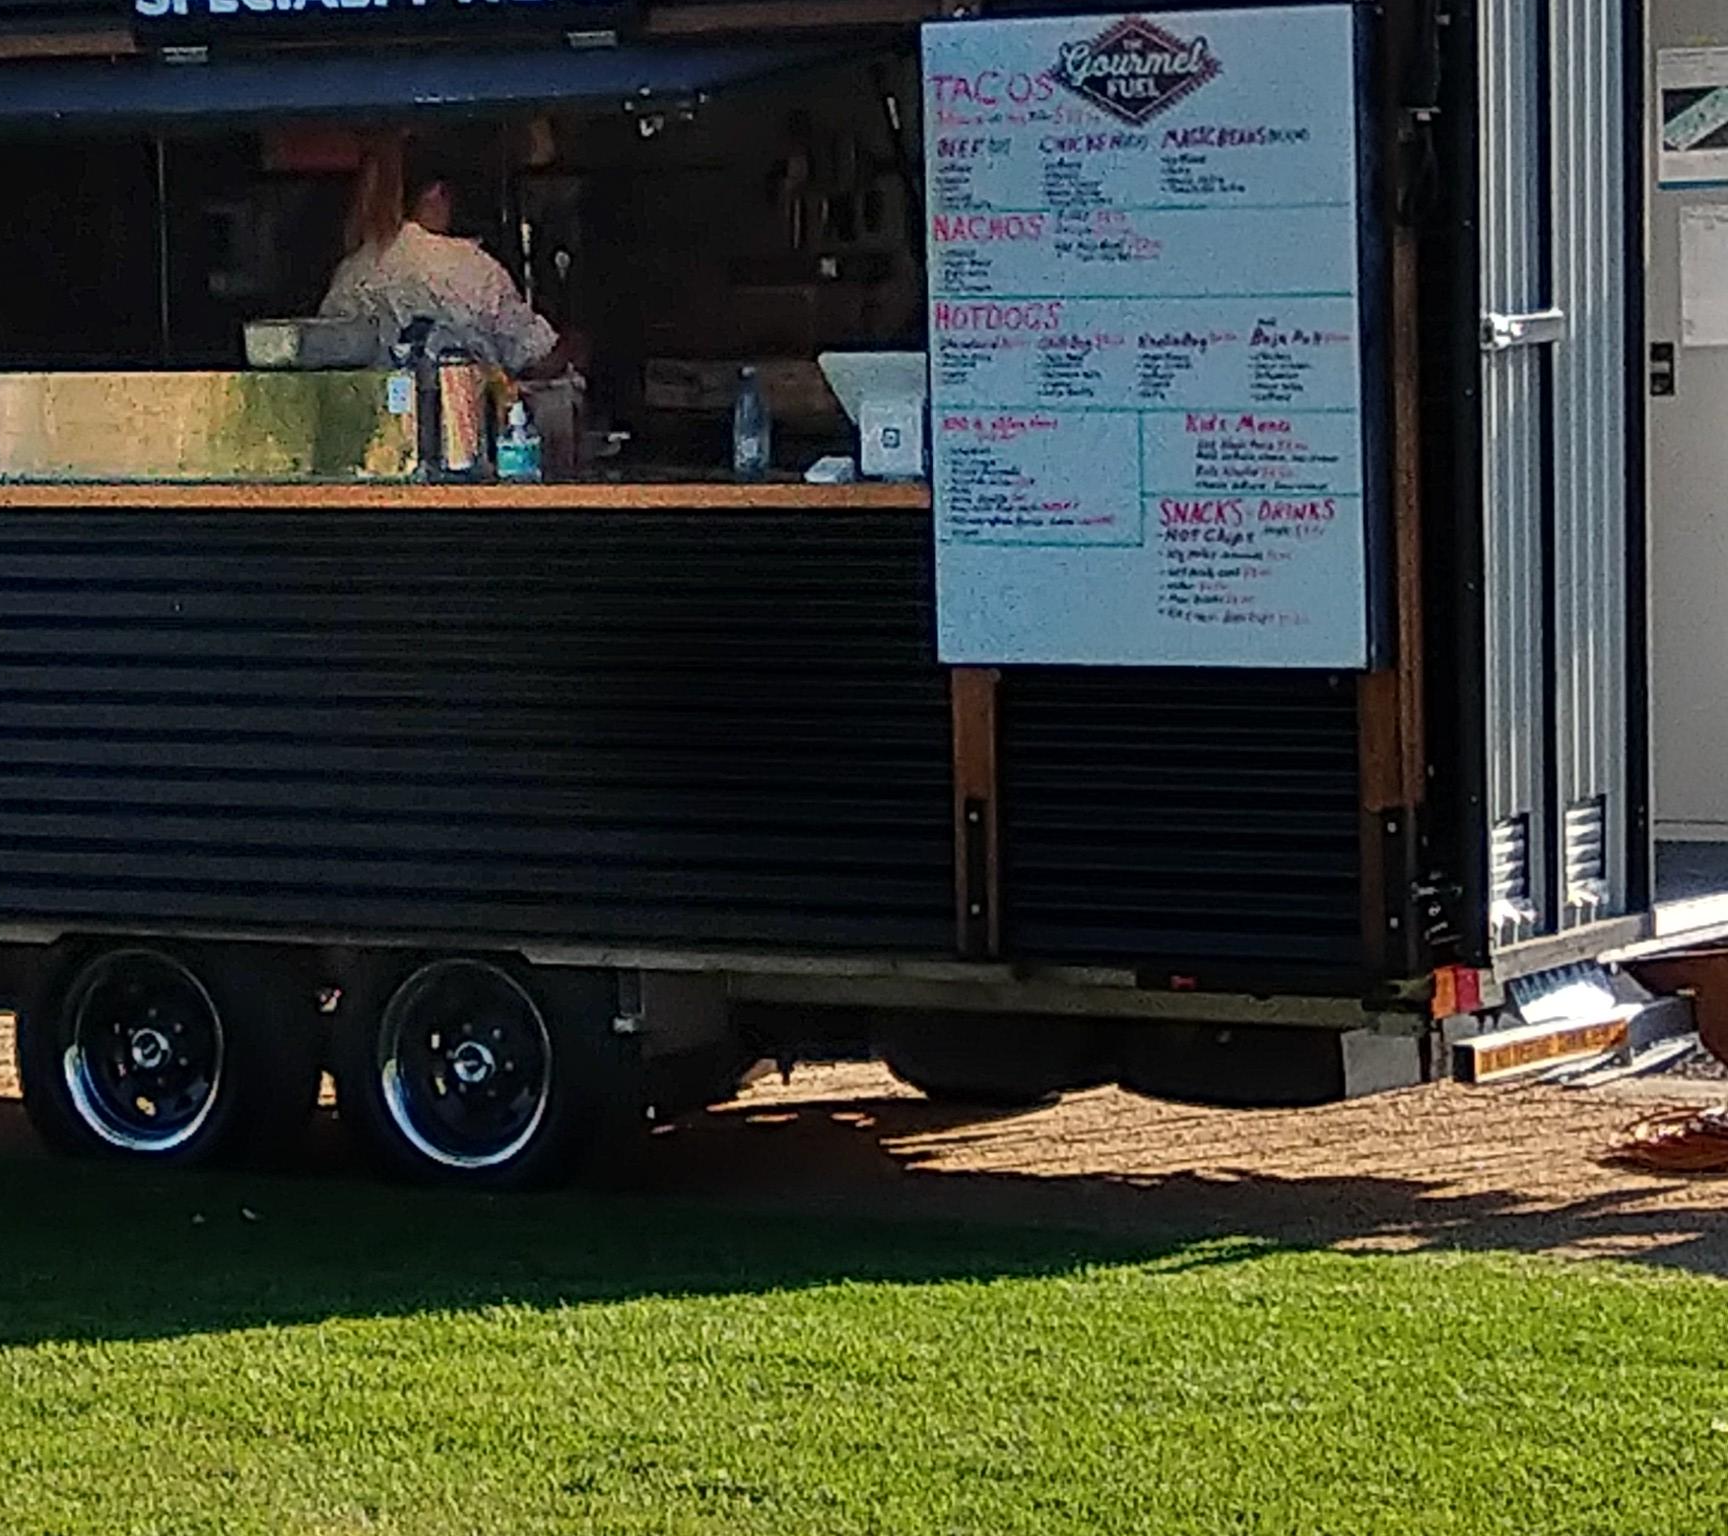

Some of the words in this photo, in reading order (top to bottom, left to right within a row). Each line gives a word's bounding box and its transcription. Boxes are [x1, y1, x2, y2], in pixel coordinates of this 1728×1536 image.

[928, 70, 1054, 105] TACOS
[1107, 77, 1161, 99] FUEL
[933, 213, 1045, 242] NACHOS
[935, 302, 1063, 330] HOTDOGS
[1159, 498, 1243, 527] SNACKS
[1257, 497, 1336, 521] DRINKS
